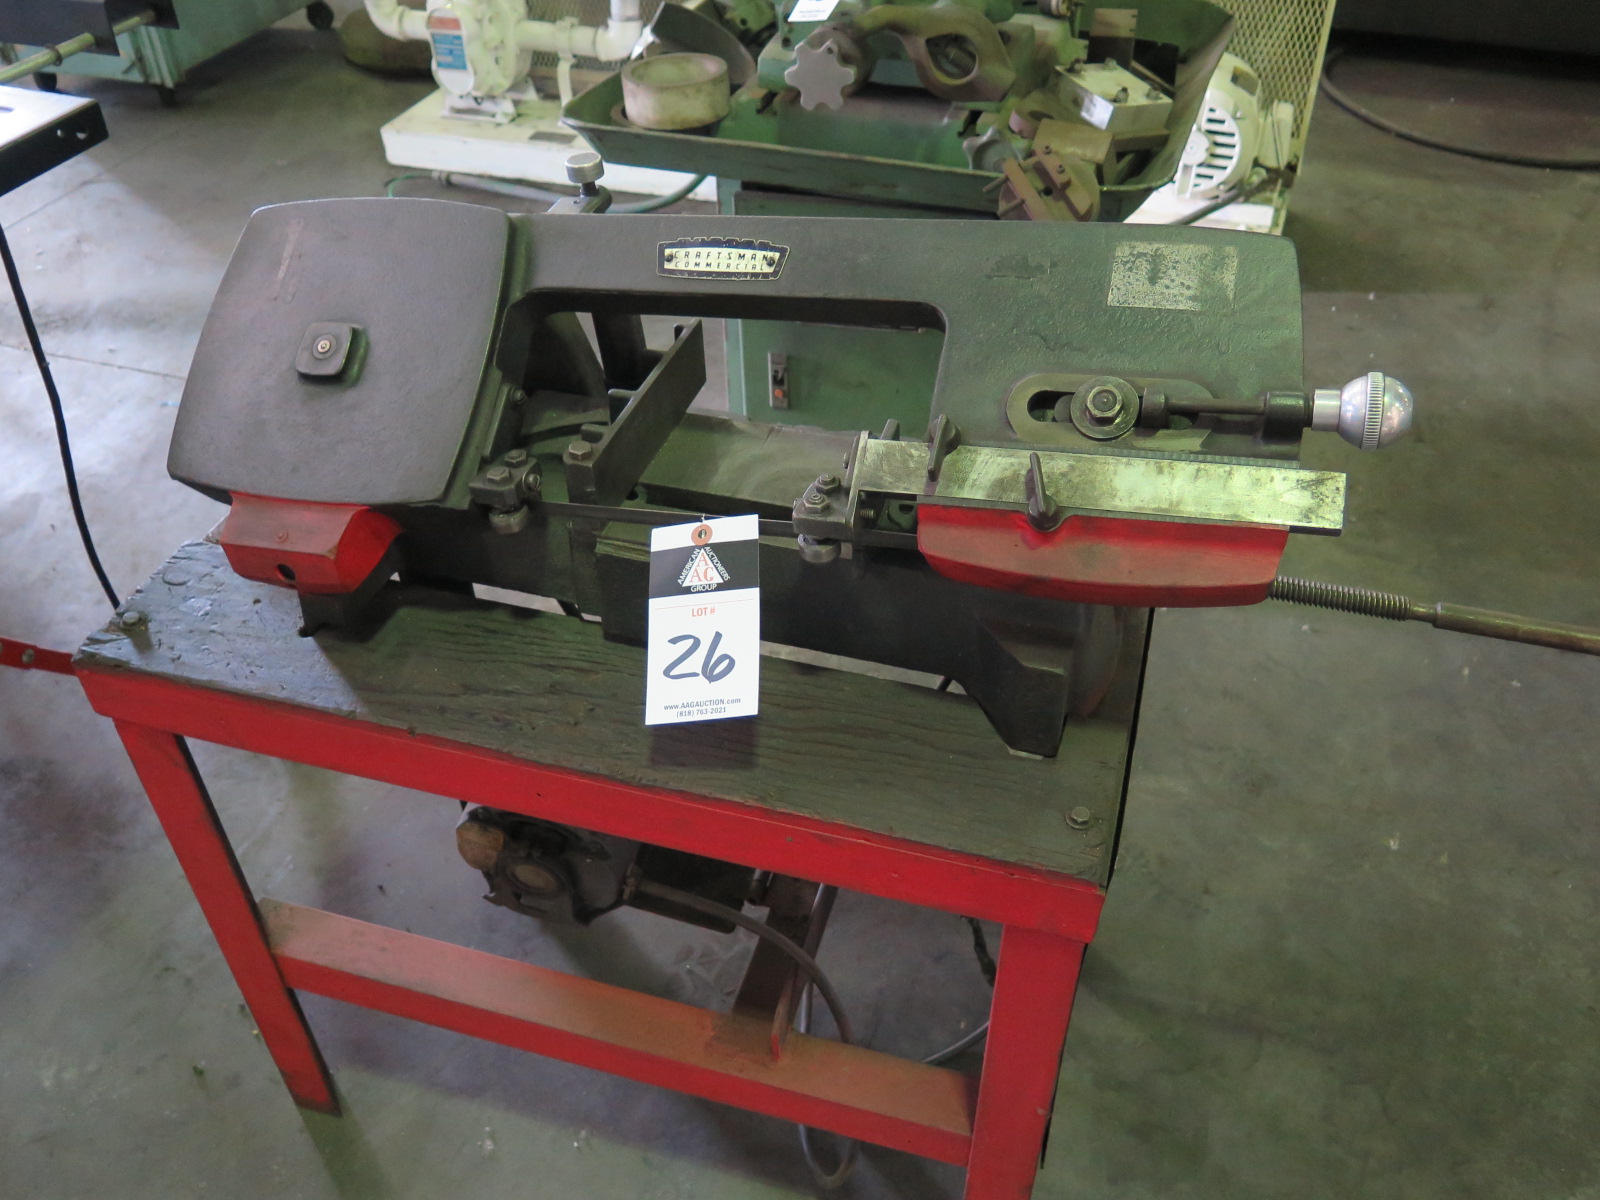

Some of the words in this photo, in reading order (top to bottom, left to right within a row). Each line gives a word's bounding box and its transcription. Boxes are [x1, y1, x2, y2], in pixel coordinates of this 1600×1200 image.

[674, 250, 768, 262] CRAFTSMAN
[674, 261, 764, 271] COMMERCIAL
[677, 548, 701, 585] AMERICAN
[704, 546, 731, 581] AUCTIONEERS
[690, 583, 717, 592] GROUP
[691, 607, 708, 617] LOT
[709, 606, 716, 616] #
[662, 631, 736, 684] 26
[663, 698, 741, 710] www.AAGAUCTION.com
[676, 709, 695, 718] (818)
[696, 706, 727, 716] 763-2021
